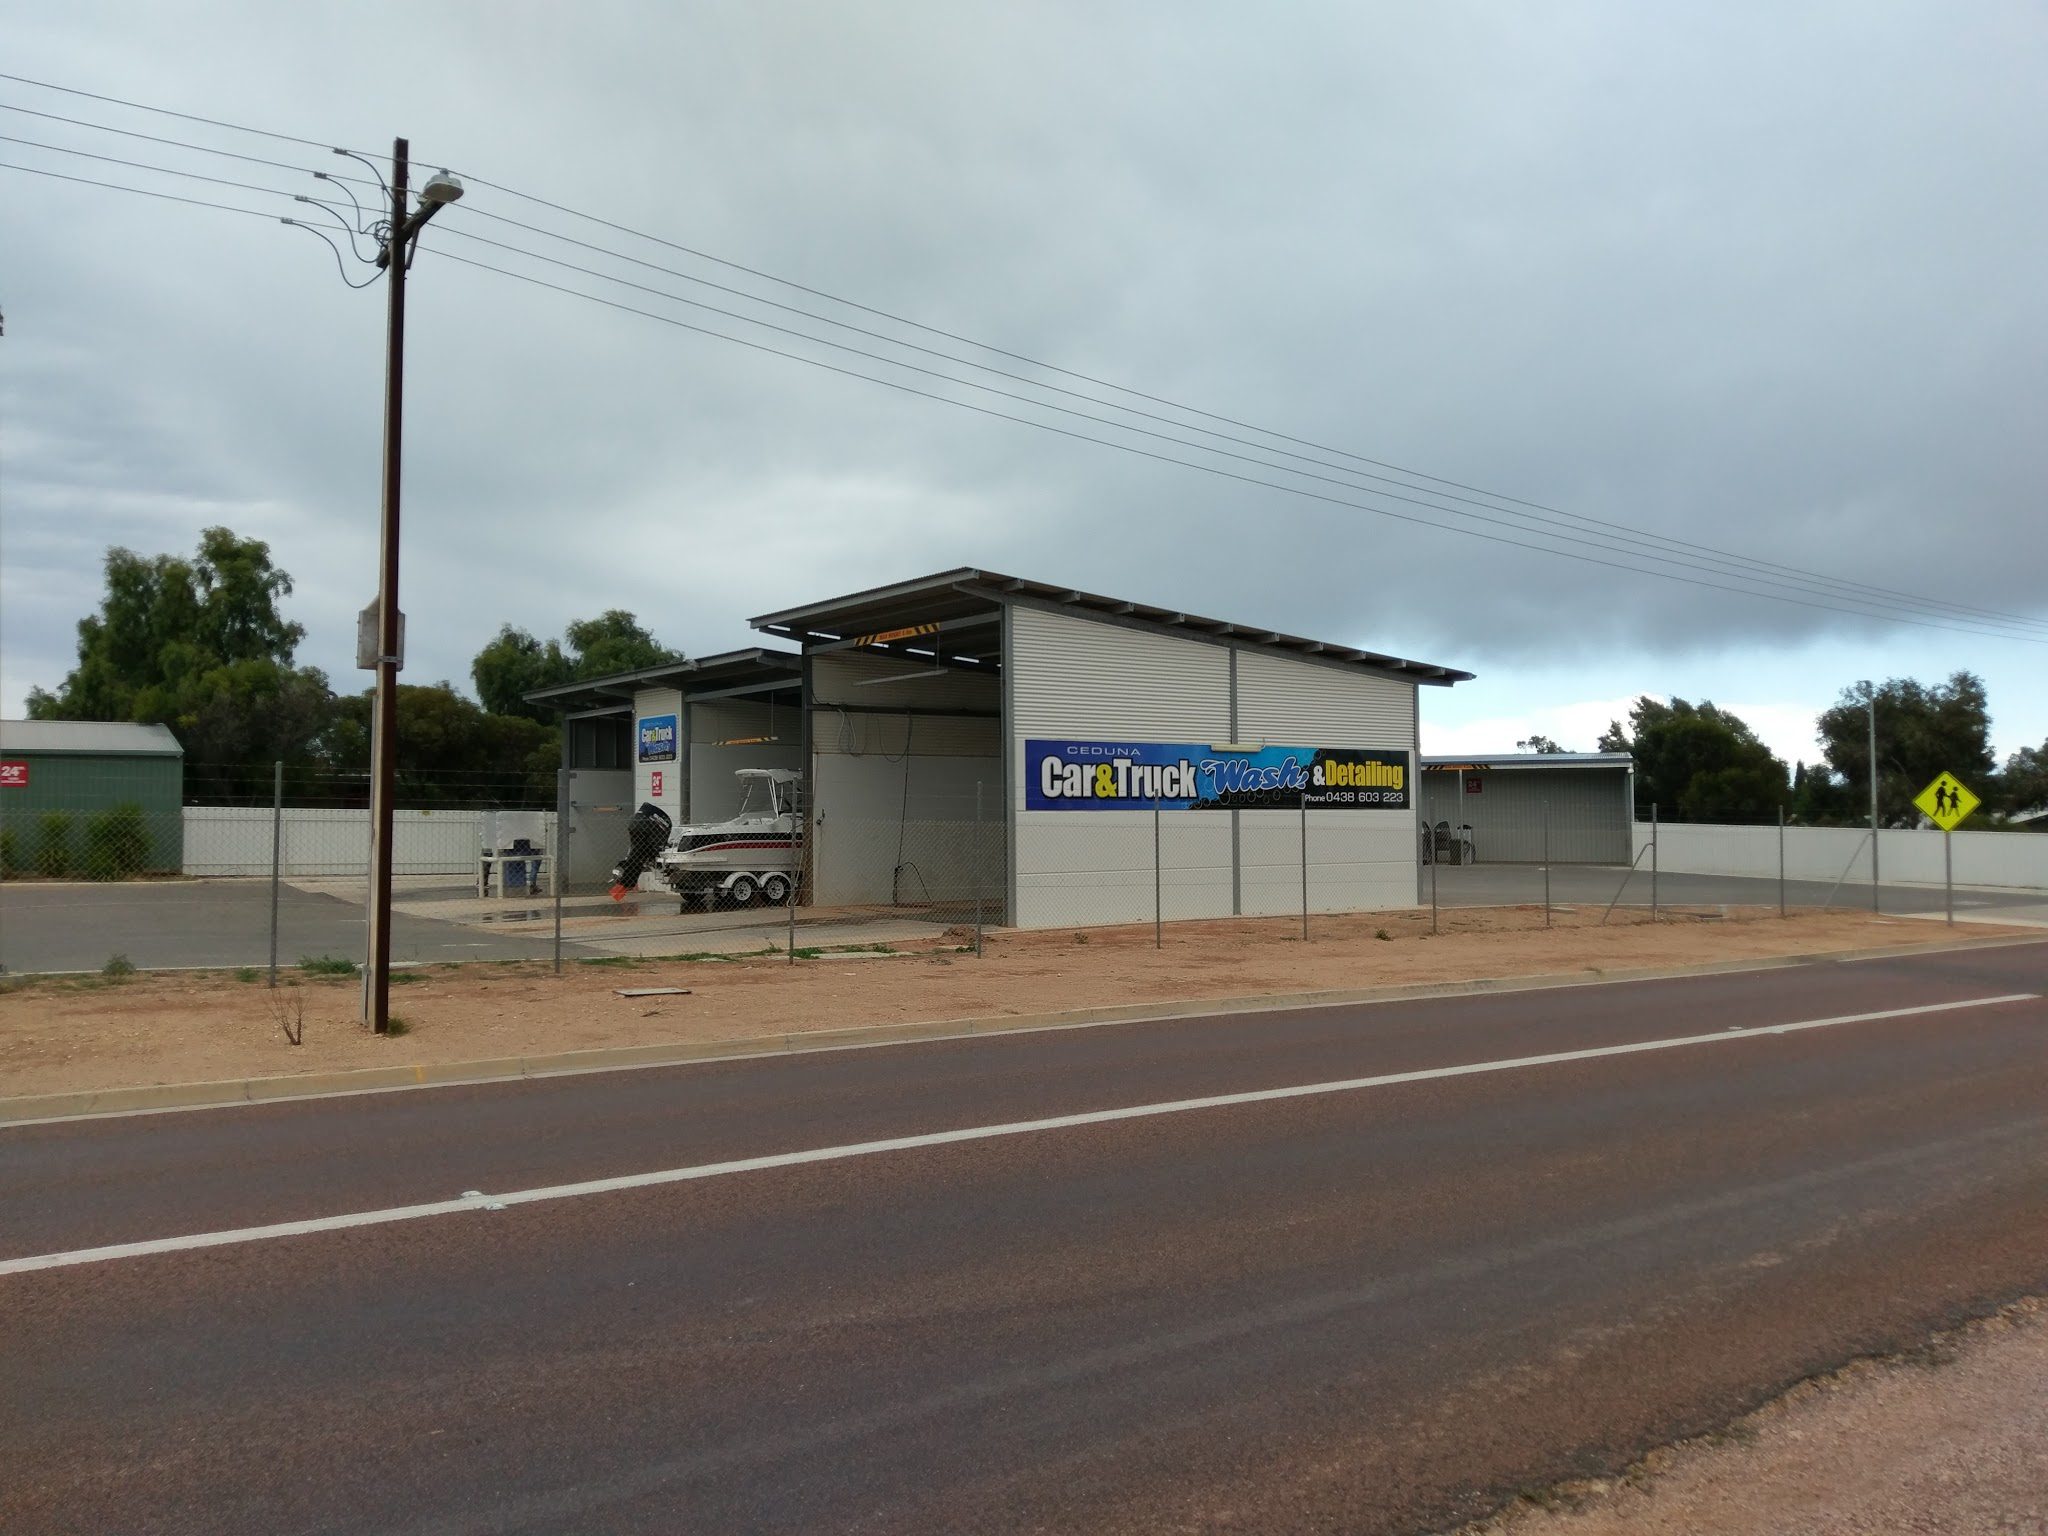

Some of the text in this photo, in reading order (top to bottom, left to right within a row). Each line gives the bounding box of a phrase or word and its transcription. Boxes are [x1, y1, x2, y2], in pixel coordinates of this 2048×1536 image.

[1067, 745, 1141, 756] CEDUNA
[1201, 756, 1309, 794] Wash
[1305, 792, 1403, 803] Phone 0438 603 223
